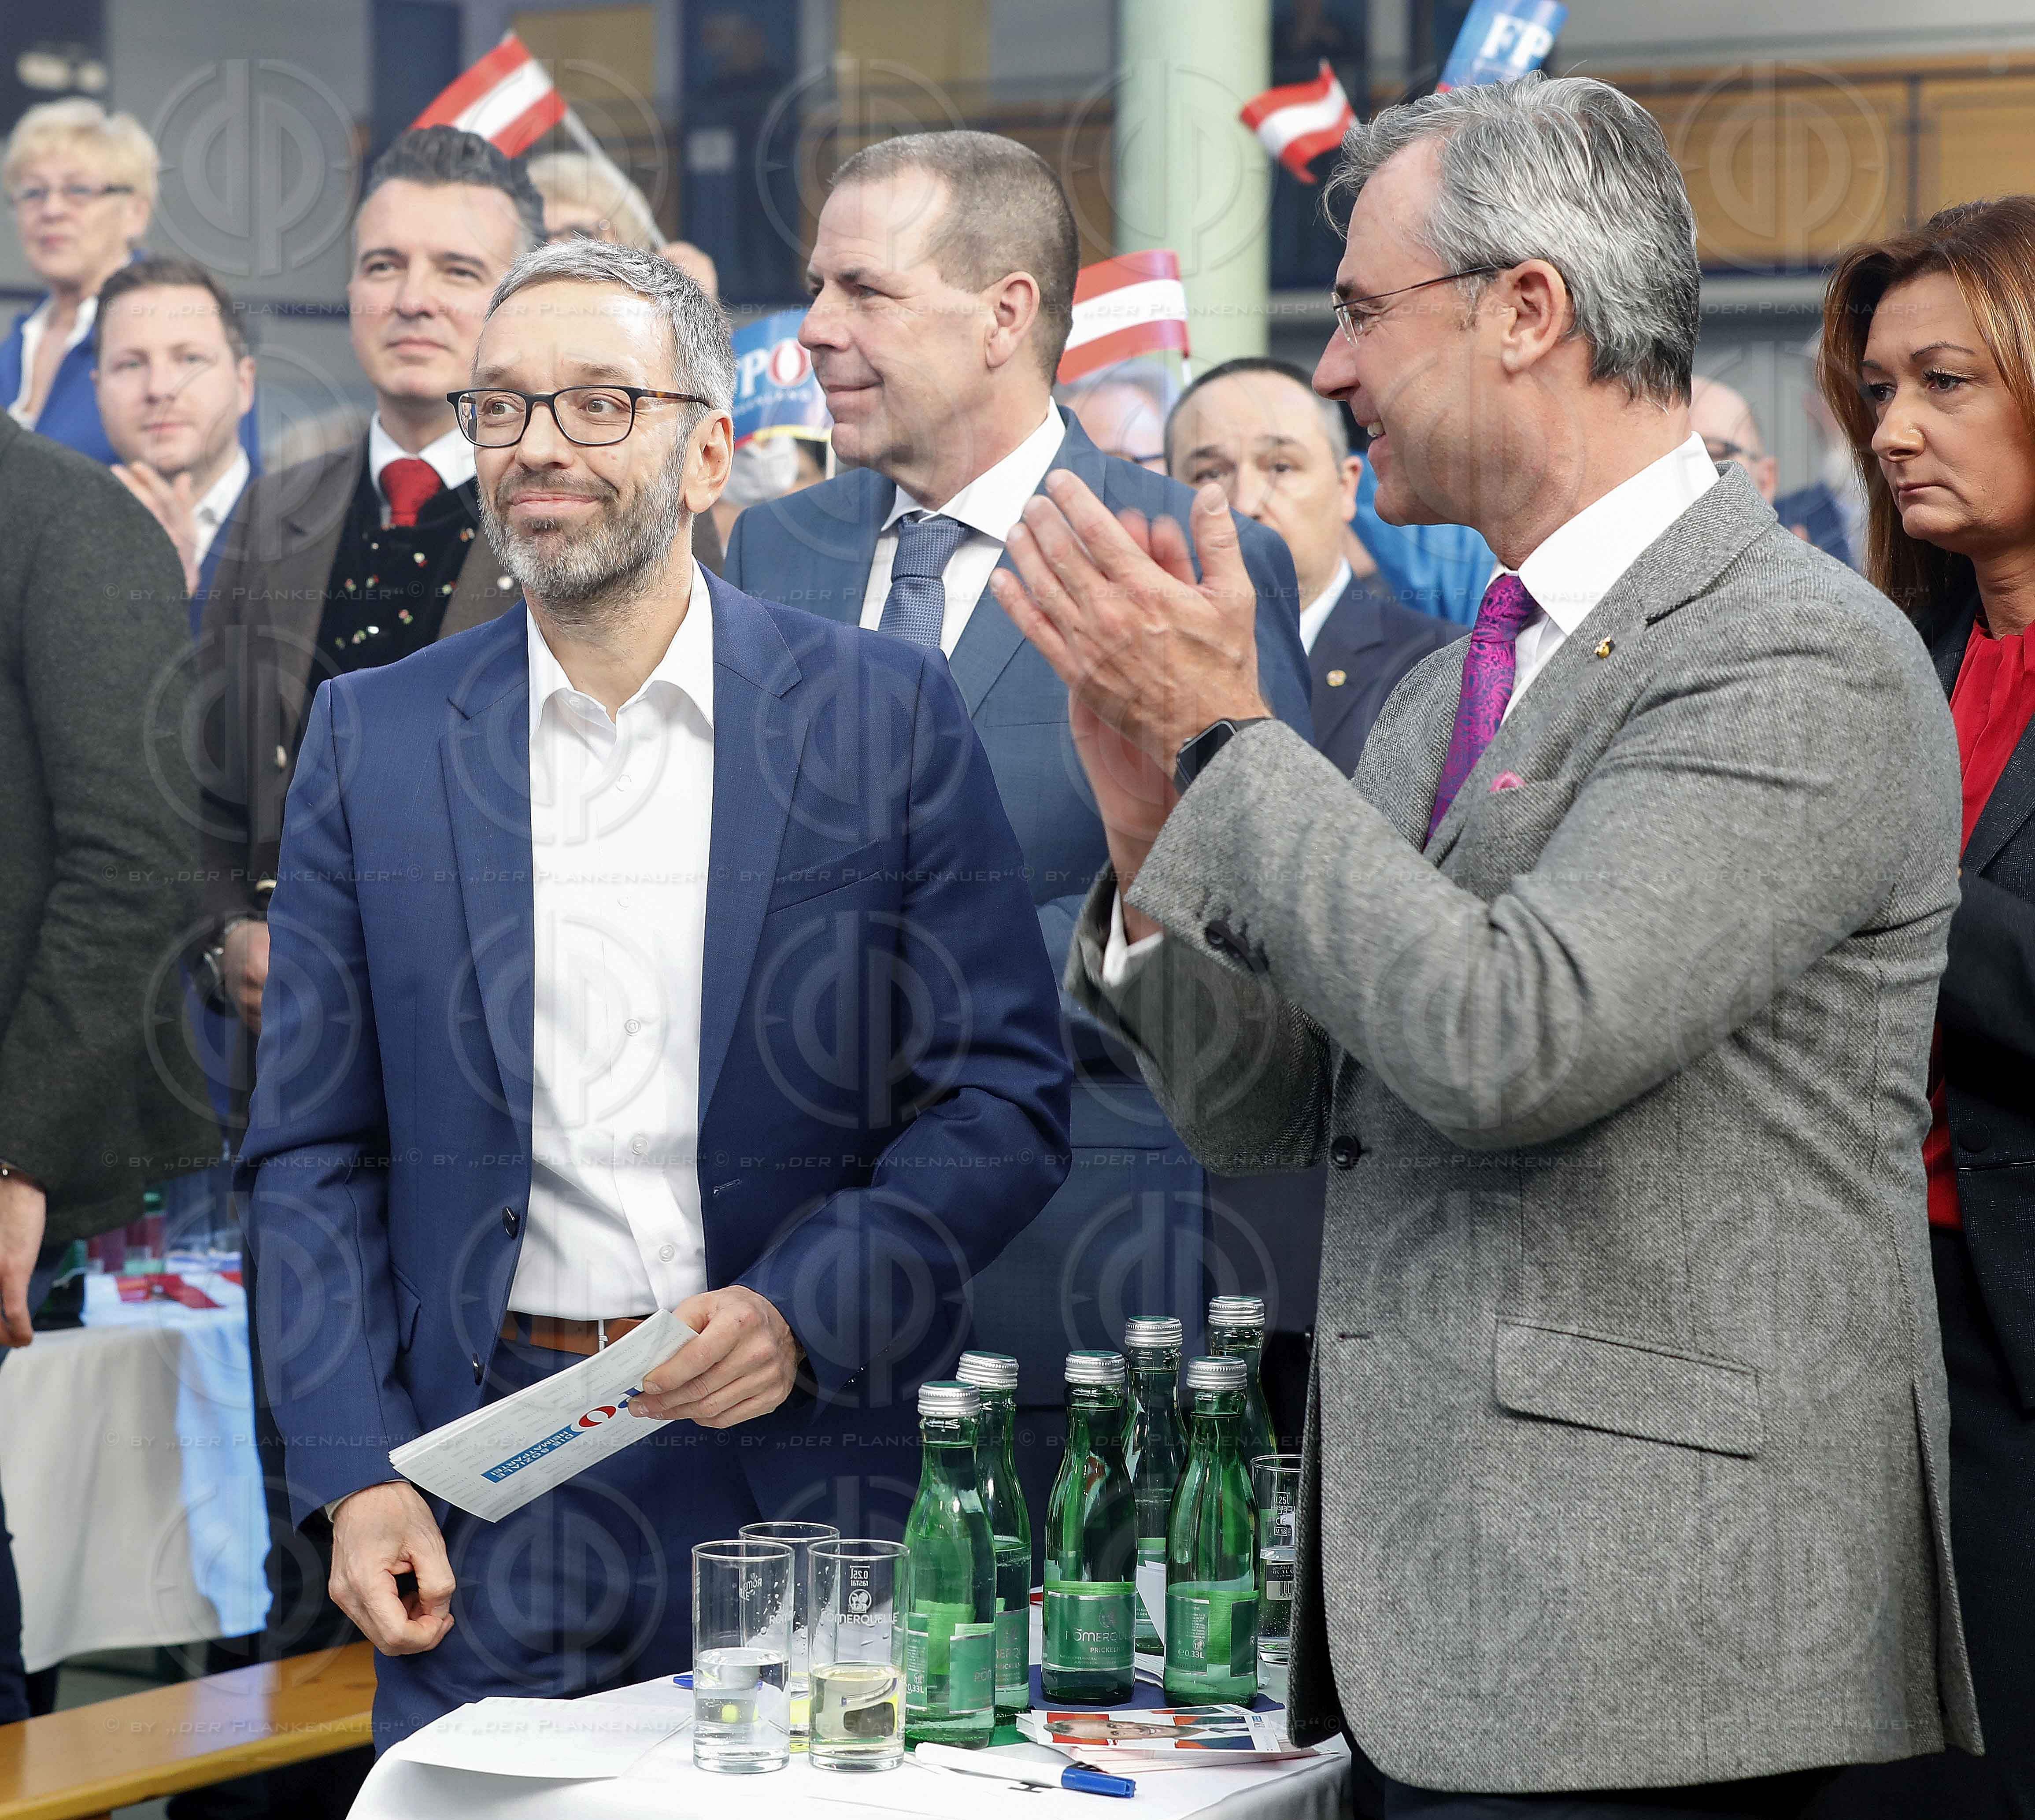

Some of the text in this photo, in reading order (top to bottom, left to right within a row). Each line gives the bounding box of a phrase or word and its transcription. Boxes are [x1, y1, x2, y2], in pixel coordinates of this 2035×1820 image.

[490, 1431, 569, 1476] HEIMATPARTEI
[496, 1433, 574, 1479] DIE SOZIALE
